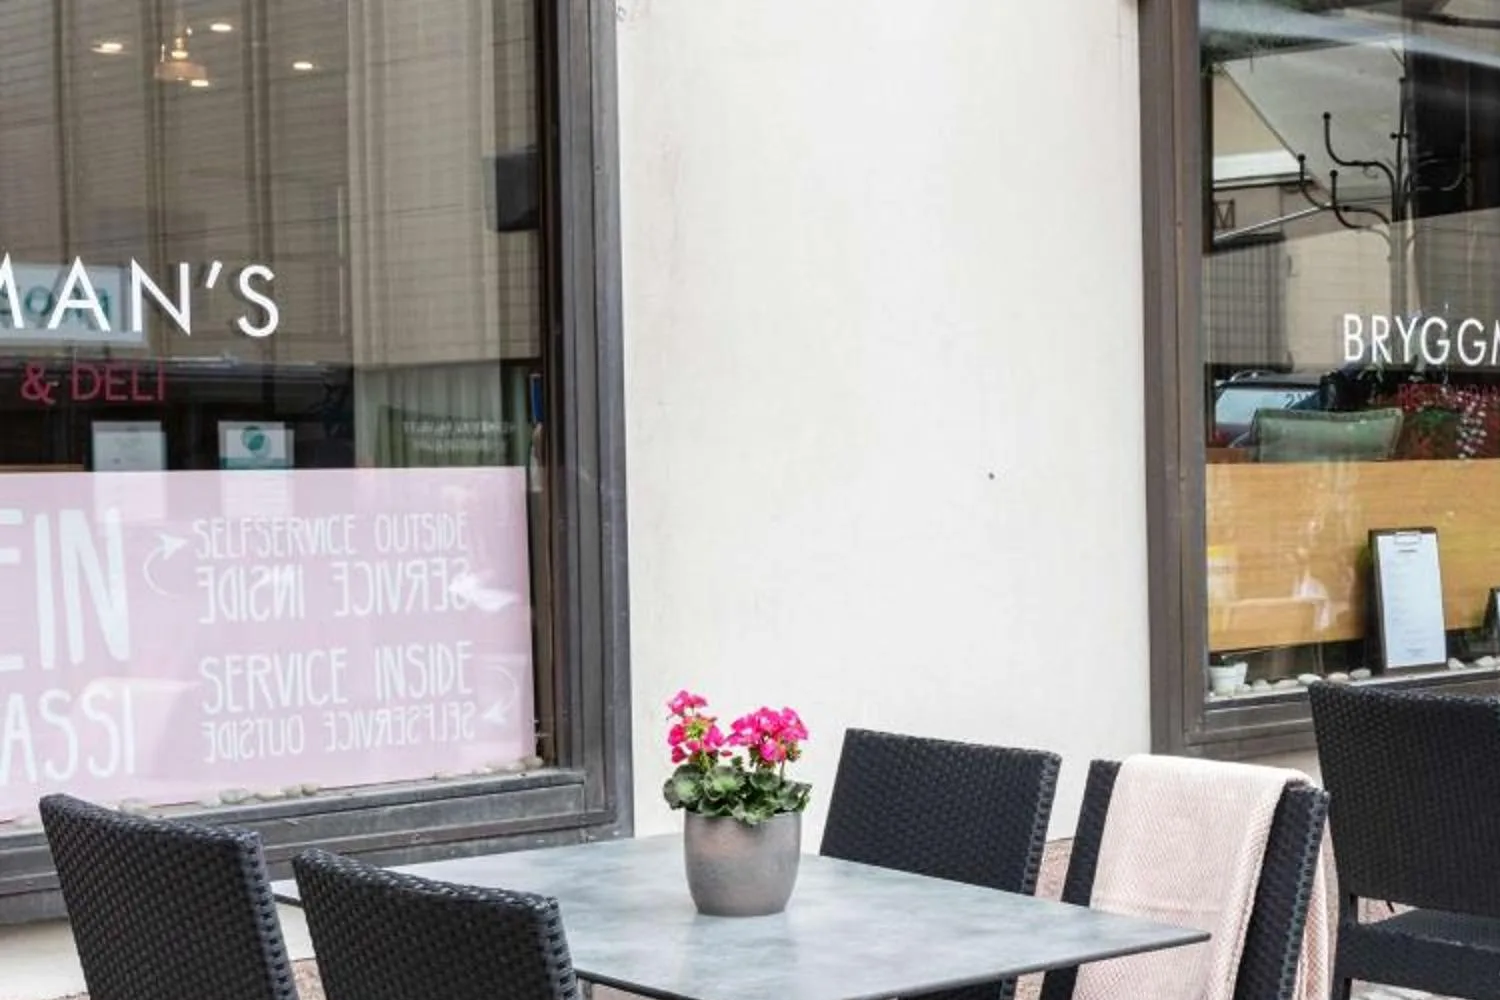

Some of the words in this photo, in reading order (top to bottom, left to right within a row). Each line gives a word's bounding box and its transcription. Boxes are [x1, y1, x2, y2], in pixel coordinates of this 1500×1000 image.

[21, 362, 58, 405] &
[70, 359, 165, 402] DELI
[193, 514, 357, 560] SELFSERVICE
[374, 511, 468, 553] OUTSIDE
[200, 648, 349, 714] SERVICE
[375, 640, 473, 701] INSIDE
